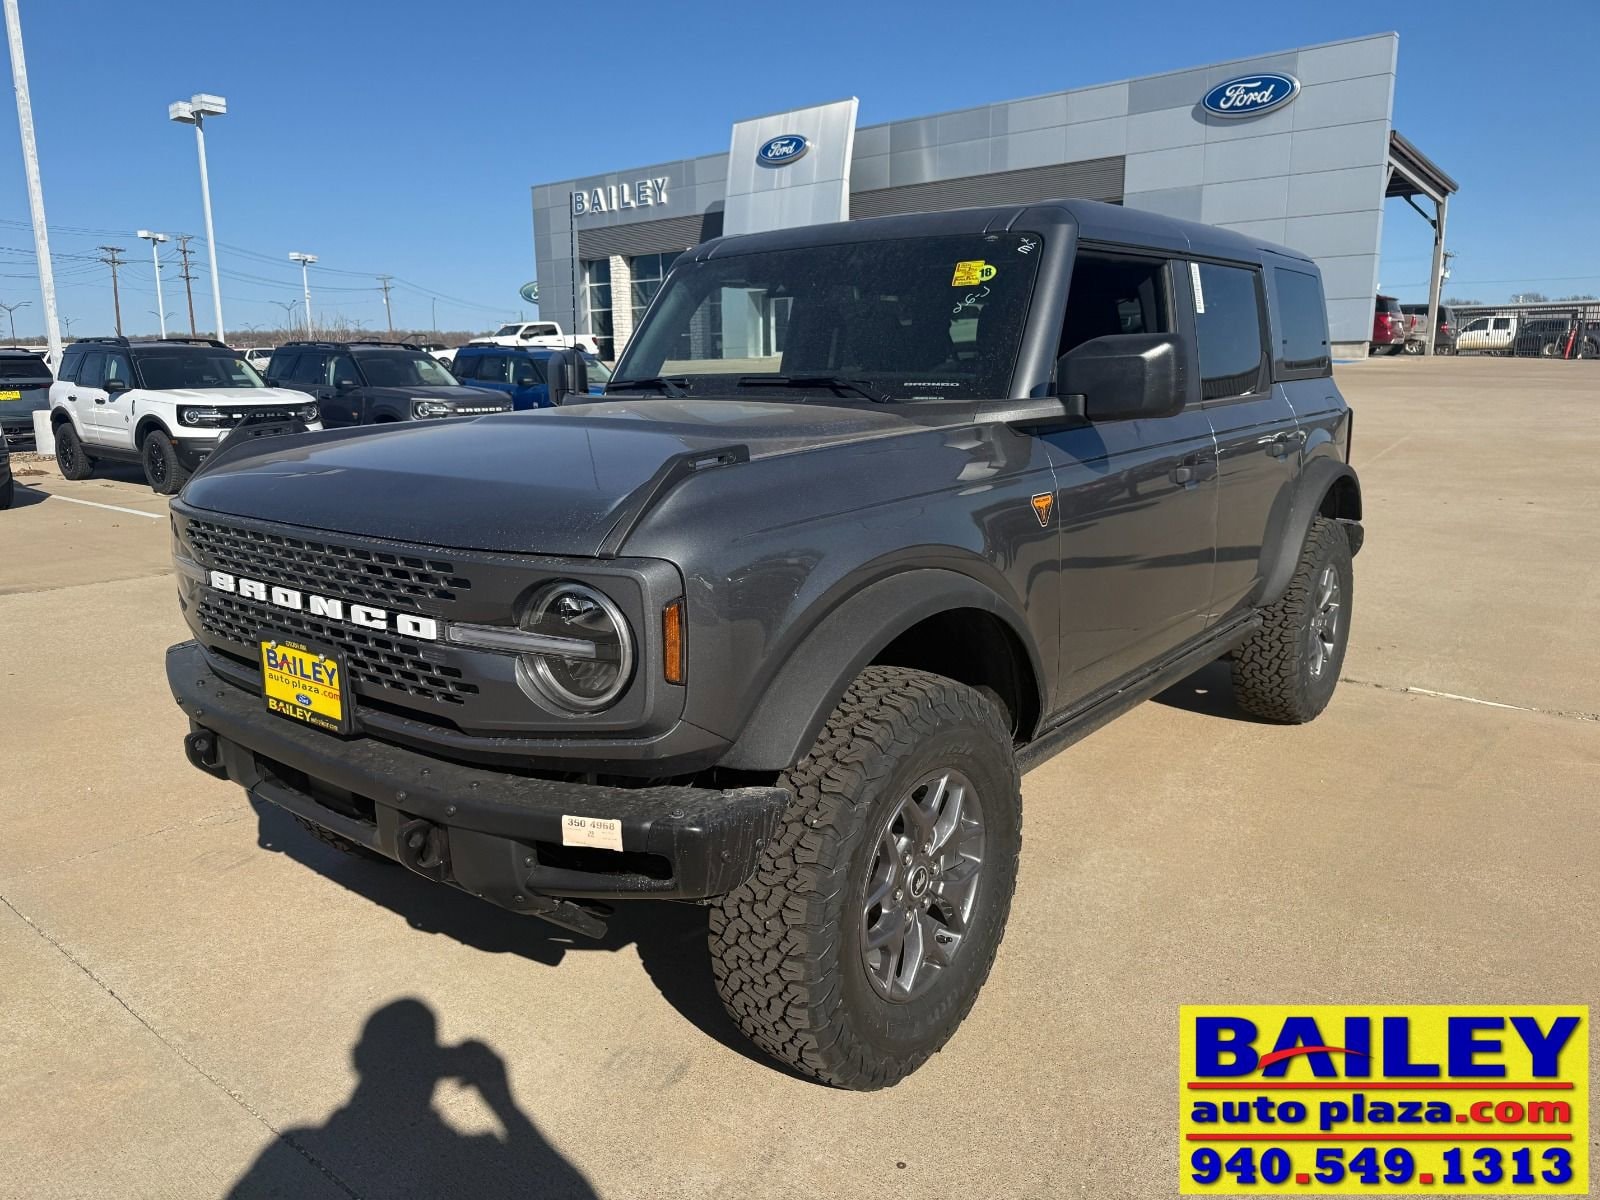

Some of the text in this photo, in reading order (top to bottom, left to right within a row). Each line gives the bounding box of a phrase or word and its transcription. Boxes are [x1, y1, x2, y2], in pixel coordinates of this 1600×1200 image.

[1219, 81, 1275, 109] Ford
[767, 140, 795, 157] Ford
[572, 176, 670, 216] BAILEY
[979, 267, 993, 279] 18
[210, 570, 437, 641] BRONCO
[265, 647, 337, 687] BAILEY
[268, 698, 312, 722] BAILEY
[567, 818, 586, 828] 350
